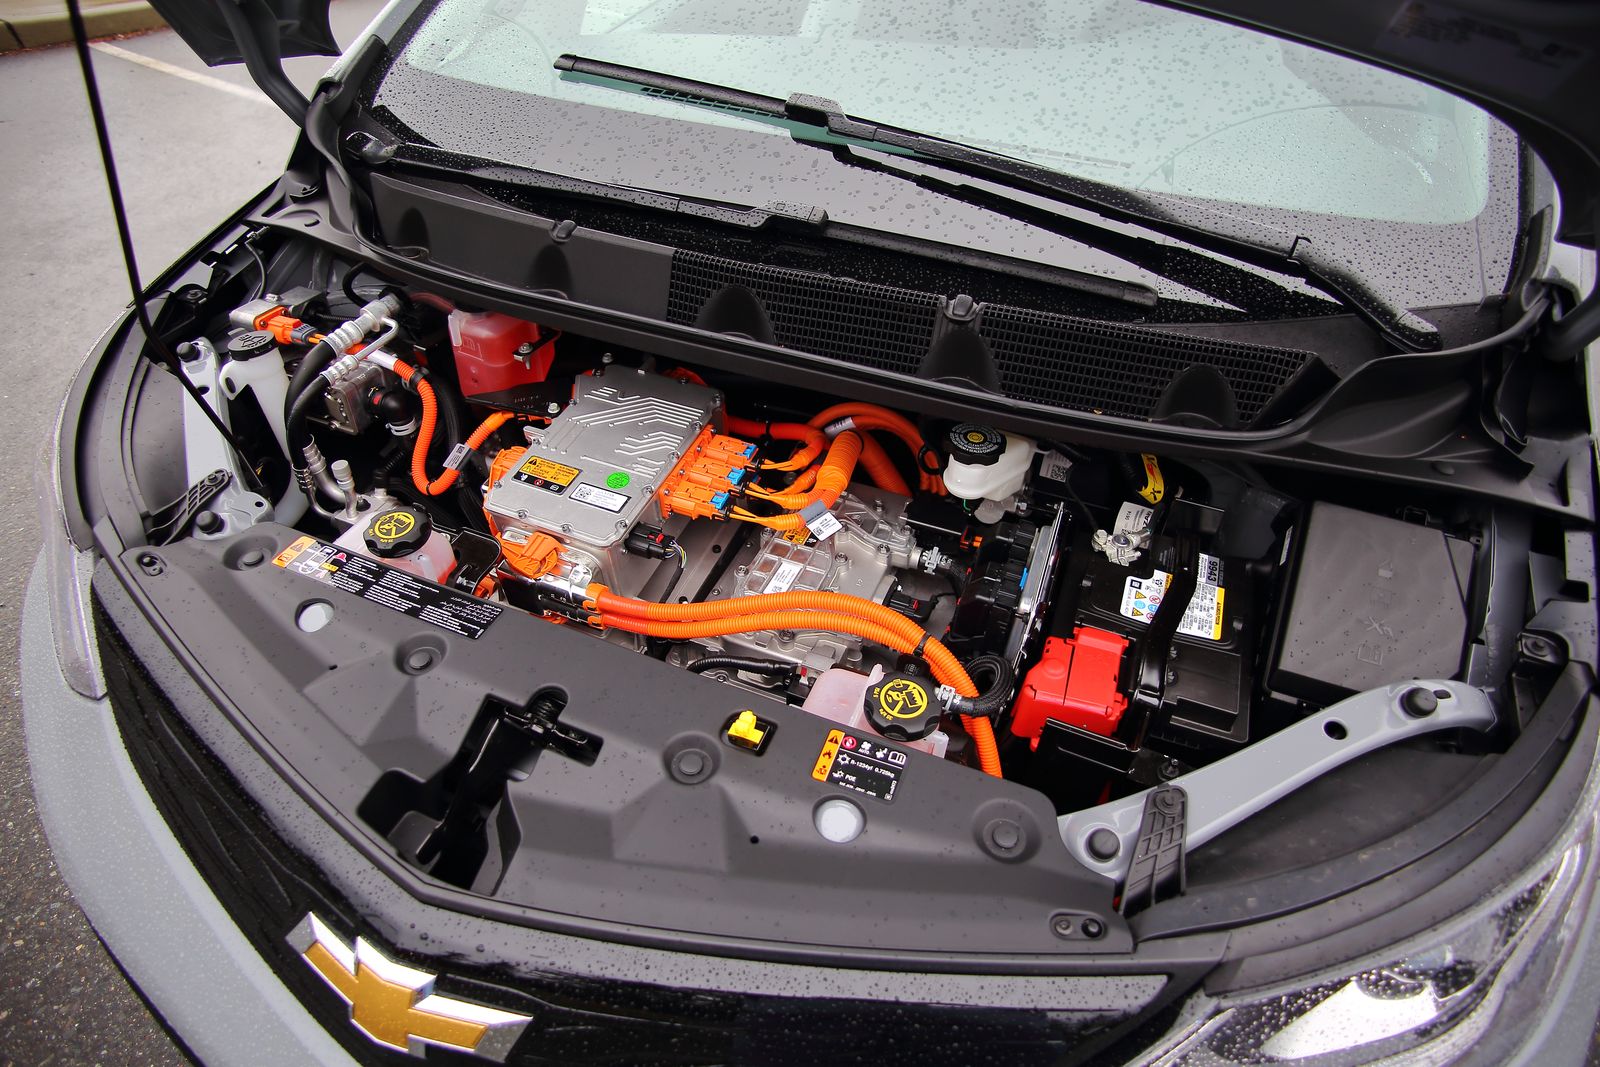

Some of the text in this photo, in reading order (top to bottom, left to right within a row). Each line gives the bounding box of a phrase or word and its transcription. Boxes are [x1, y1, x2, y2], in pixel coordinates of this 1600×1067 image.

[1207, 560, 1218, 582] 9943
[850, 760, 873, 770] R-1234yf
[845, 774, 857, 782] POE
